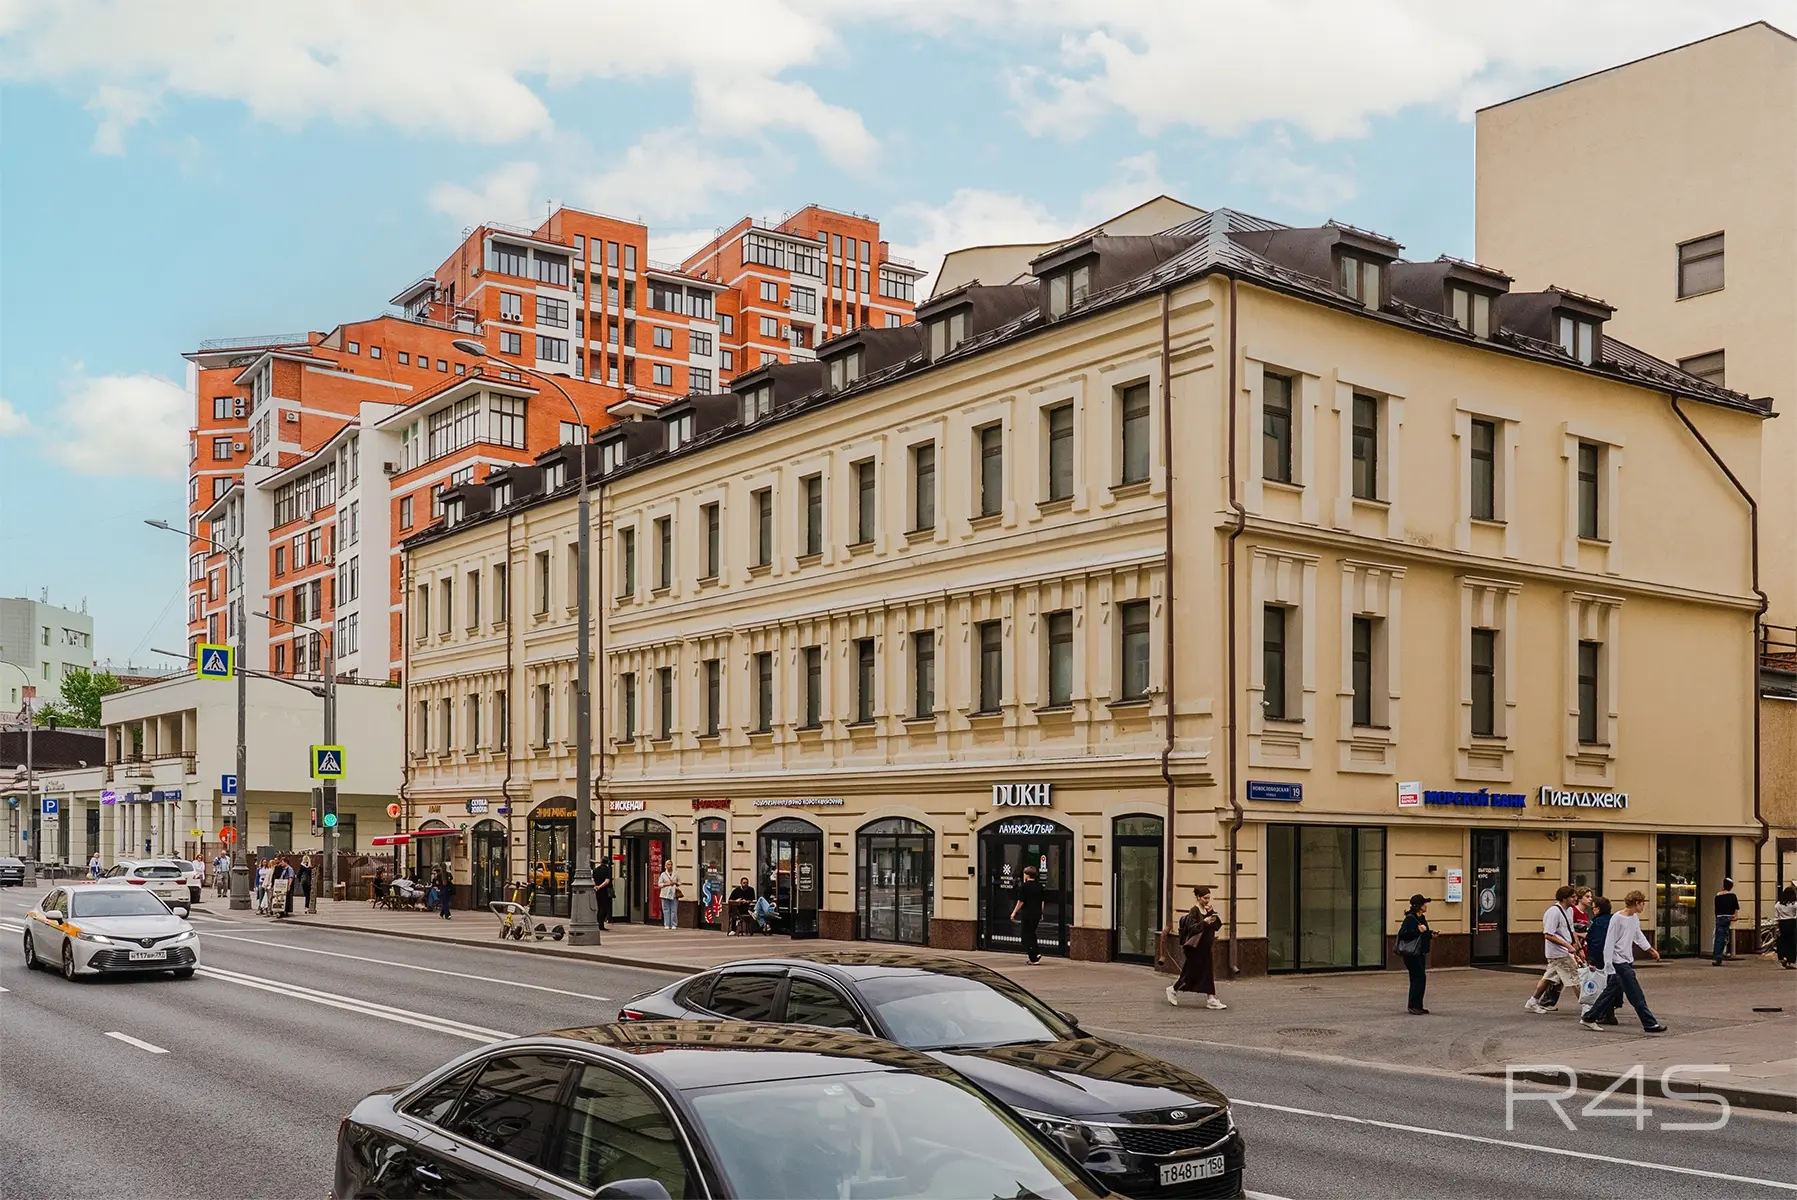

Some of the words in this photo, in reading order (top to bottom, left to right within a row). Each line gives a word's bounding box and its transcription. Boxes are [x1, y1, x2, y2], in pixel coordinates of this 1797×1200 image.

[992, 783, 1051, 806] DUKH
[1292, 787, 1301, 797] 19
[1424, 788, 1490, 806] МОРСКОЙ
[1490, 793, 1527, 808] БАНК
[1541, 785, 1629, 808] Гиалджект
[46, 800, 56, 812] P
[998, 824, 1023, 834] ЛАУНЖ
[1022, 823, 1041, 835] 24/7
[1040, 824, 1054, 834] БАР
[1163, 1163, 1205, 1183] Т848ТТ
[1207, 1157, 1223, 1171] 150
